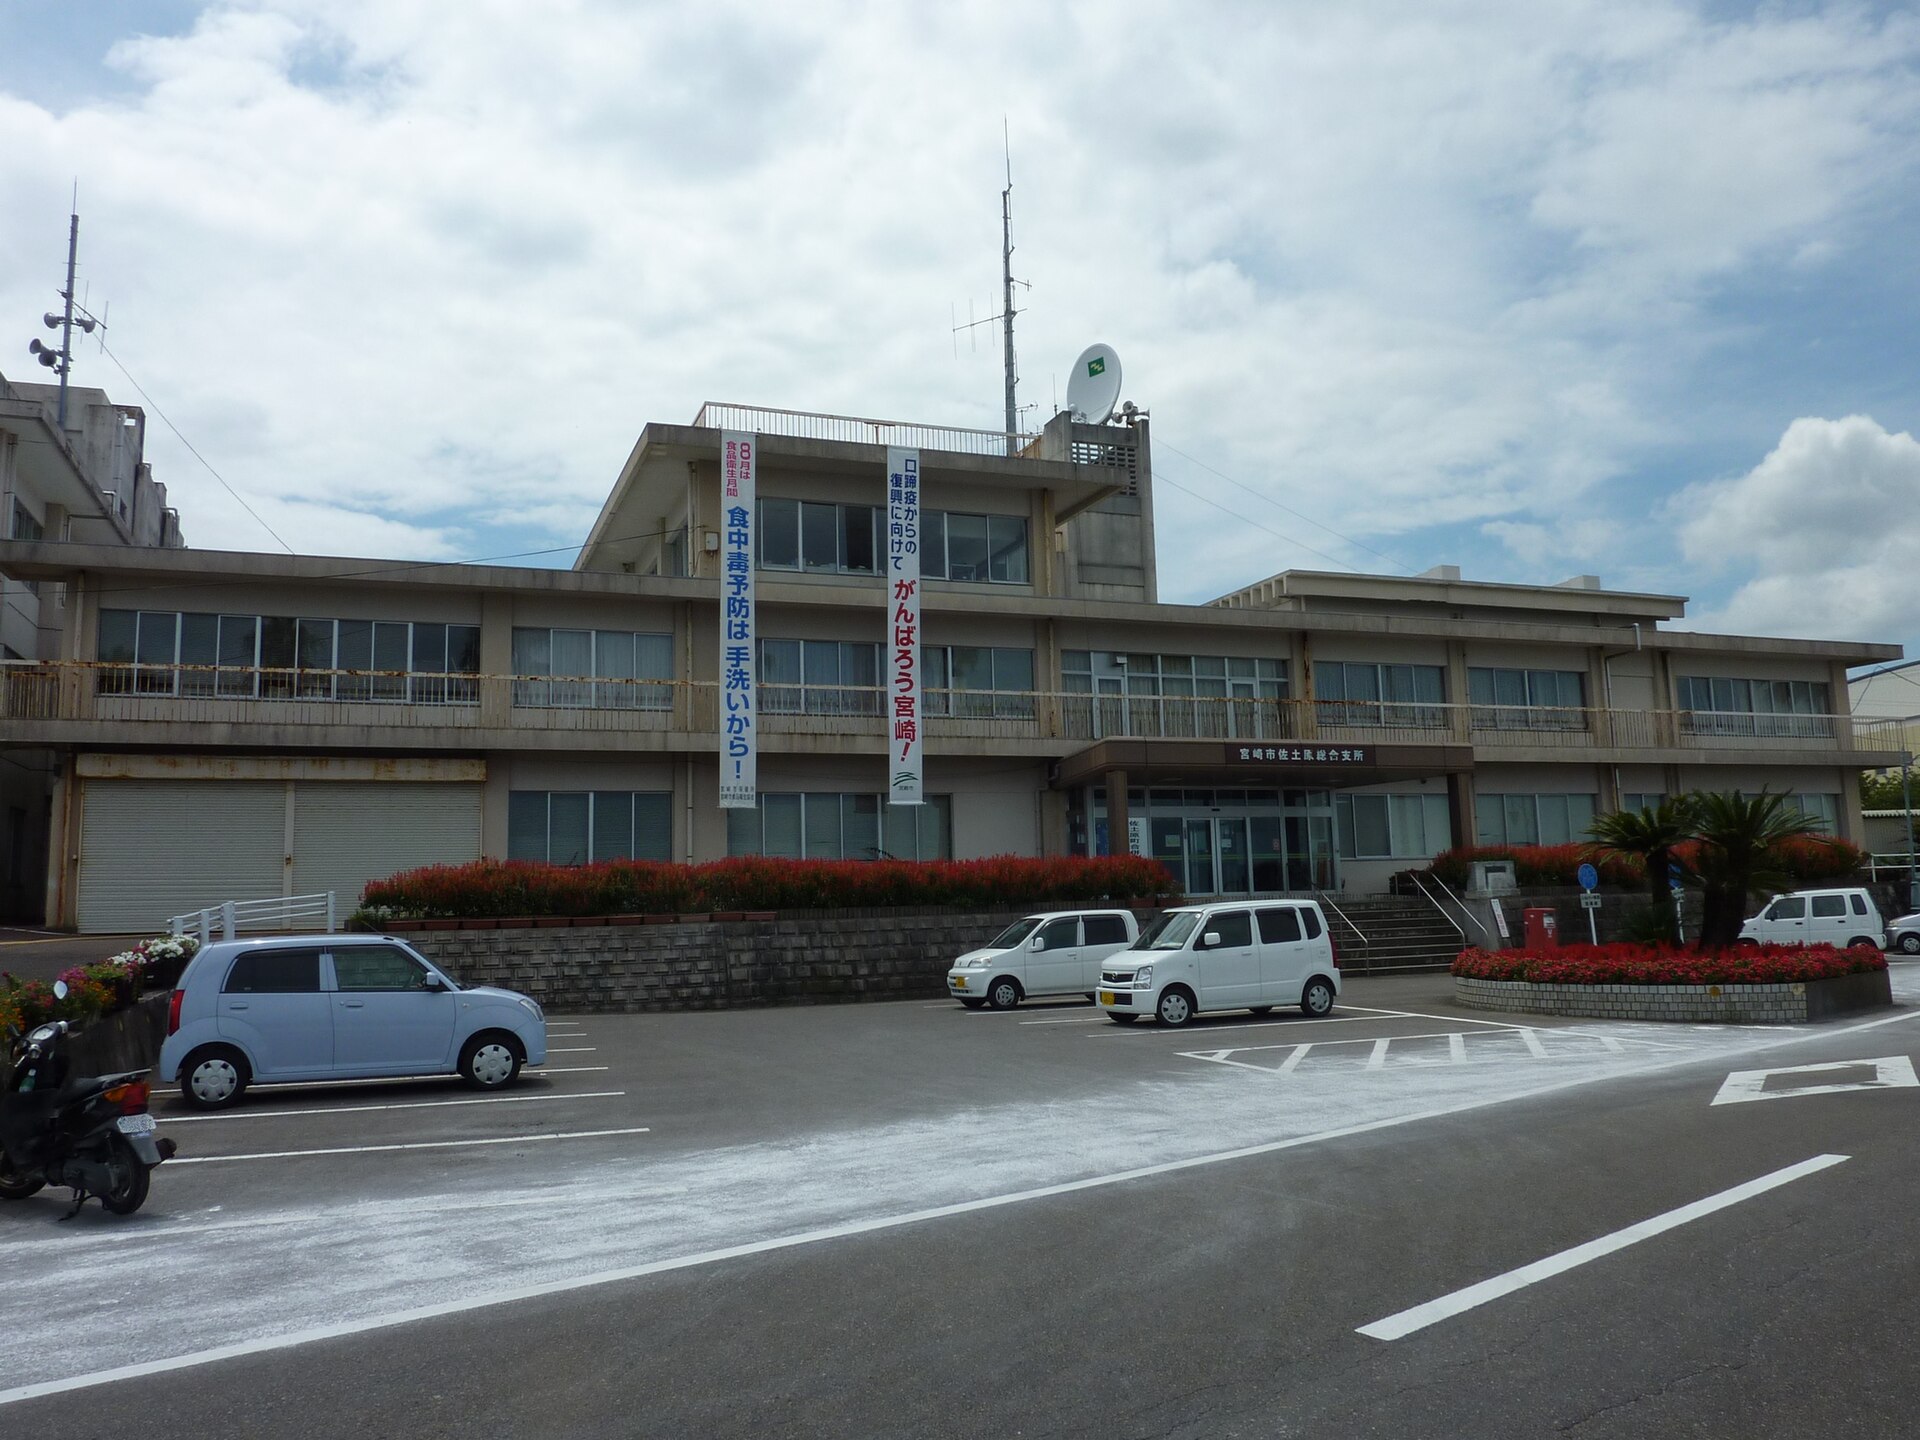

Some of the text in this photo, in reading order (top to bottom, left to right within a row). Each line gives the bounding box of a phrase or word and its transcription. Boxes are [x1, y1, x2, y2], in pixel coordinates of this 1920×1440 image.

[740, 442, 751, 480] 8月は
[890, 472, 904, 571] 復興に向けて
[904, 458, 917, 555] 口蹄疫からの
[1239, 747, 1364, 762] 宮崎市佐土原総合支所
